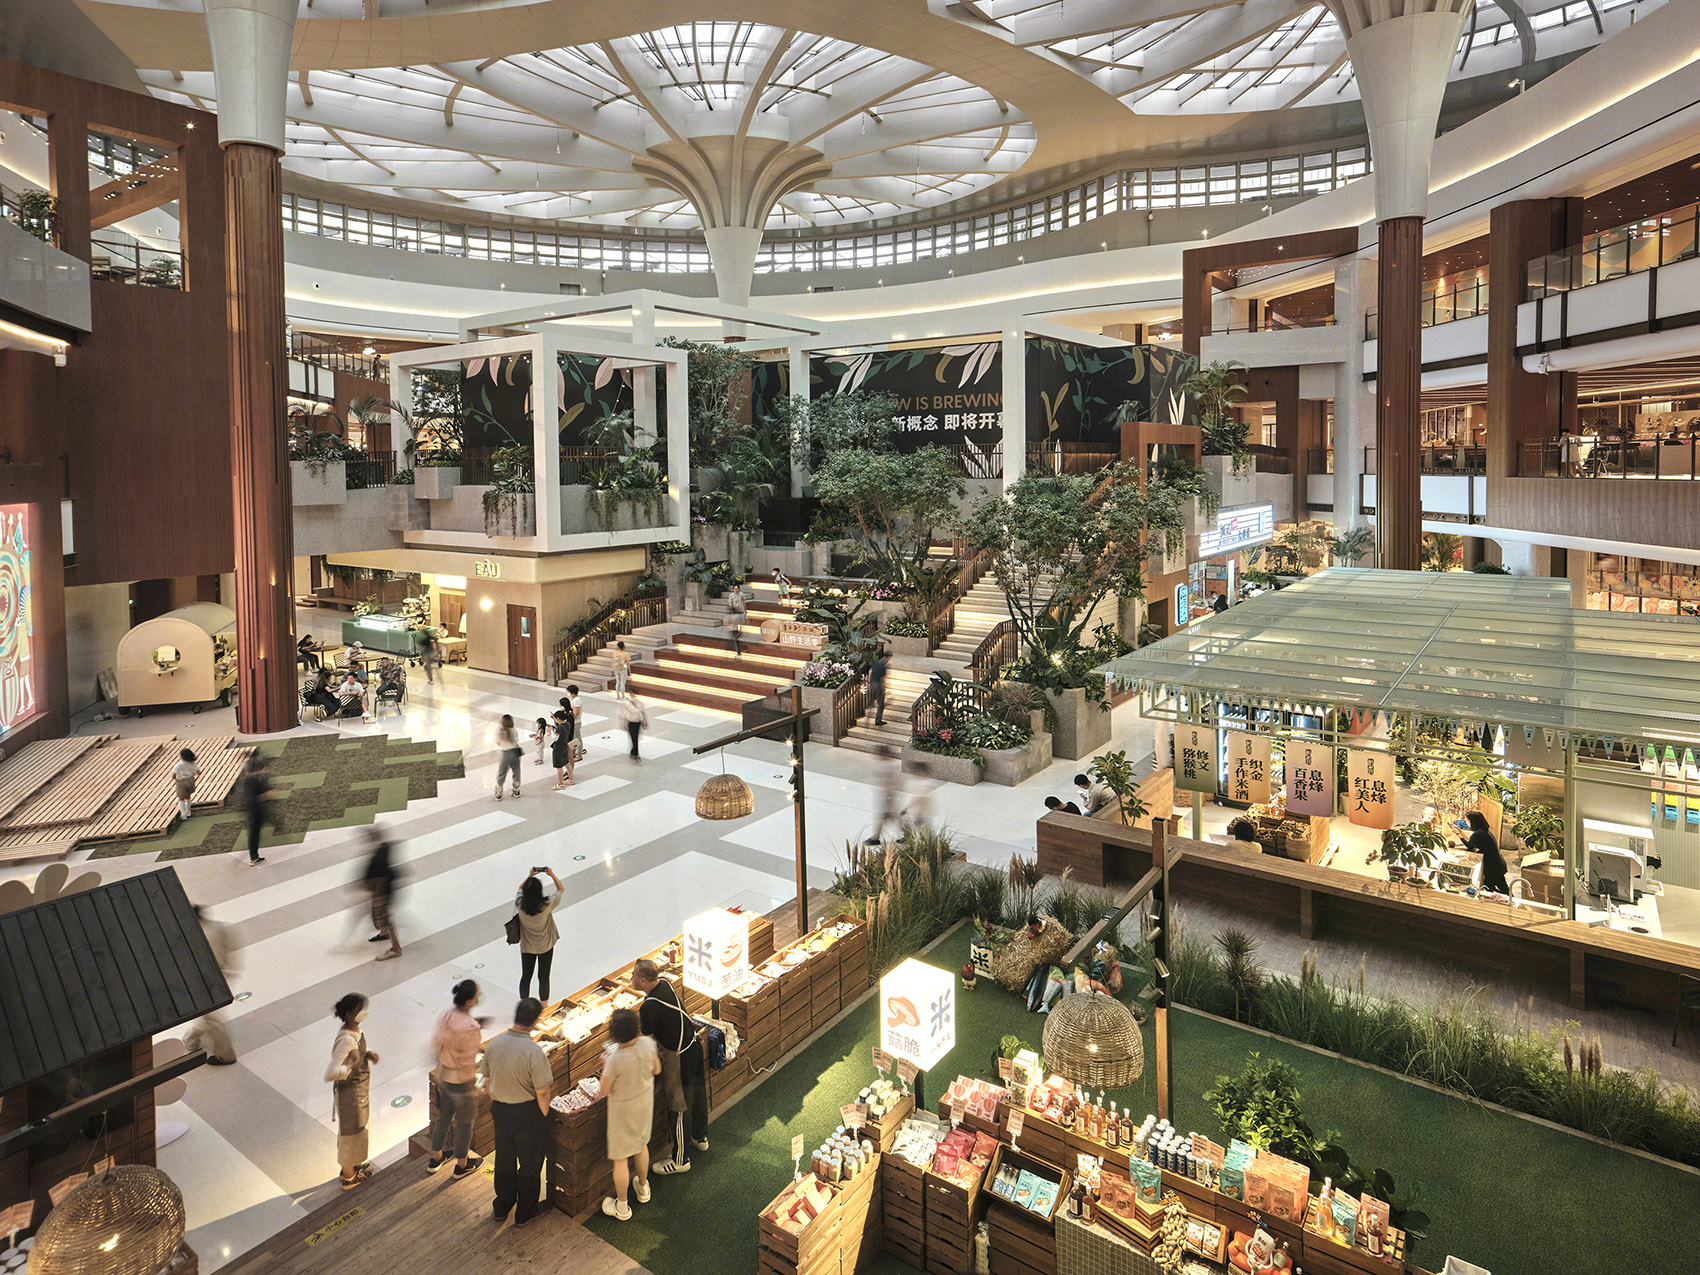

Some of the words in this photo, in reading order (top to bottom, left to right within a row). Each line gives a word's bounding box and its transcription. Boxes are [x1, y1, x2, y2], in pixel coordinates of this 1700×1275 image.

[916, 396, 929, 410] IS
[933, 392, 1003, 410] BREWIN
[1182, 747, 1197, 779] 猕猴桃
[1196, 749, 1209, 771] 修文
[1249, 758, 1263, 782] 织金
[1234, 757, 1249, 800] 手作米酒
[1294, 766, 1308, 801] 百香果
[1308, 769, 1324, 793] 息烽
[1354, 776, 1370, 813] 红美人
[1370, 780, 1387, 804] 息烽
[688, 933, 712, 972] 米
[973, 949, 990, 969] 米
[687, 969, 712, 987] YMSJ
[721, 966, 744, 990] 葱油
[930, 987, 951, 1038] 米
[887, 1029, 920, 1057] 菇脆
